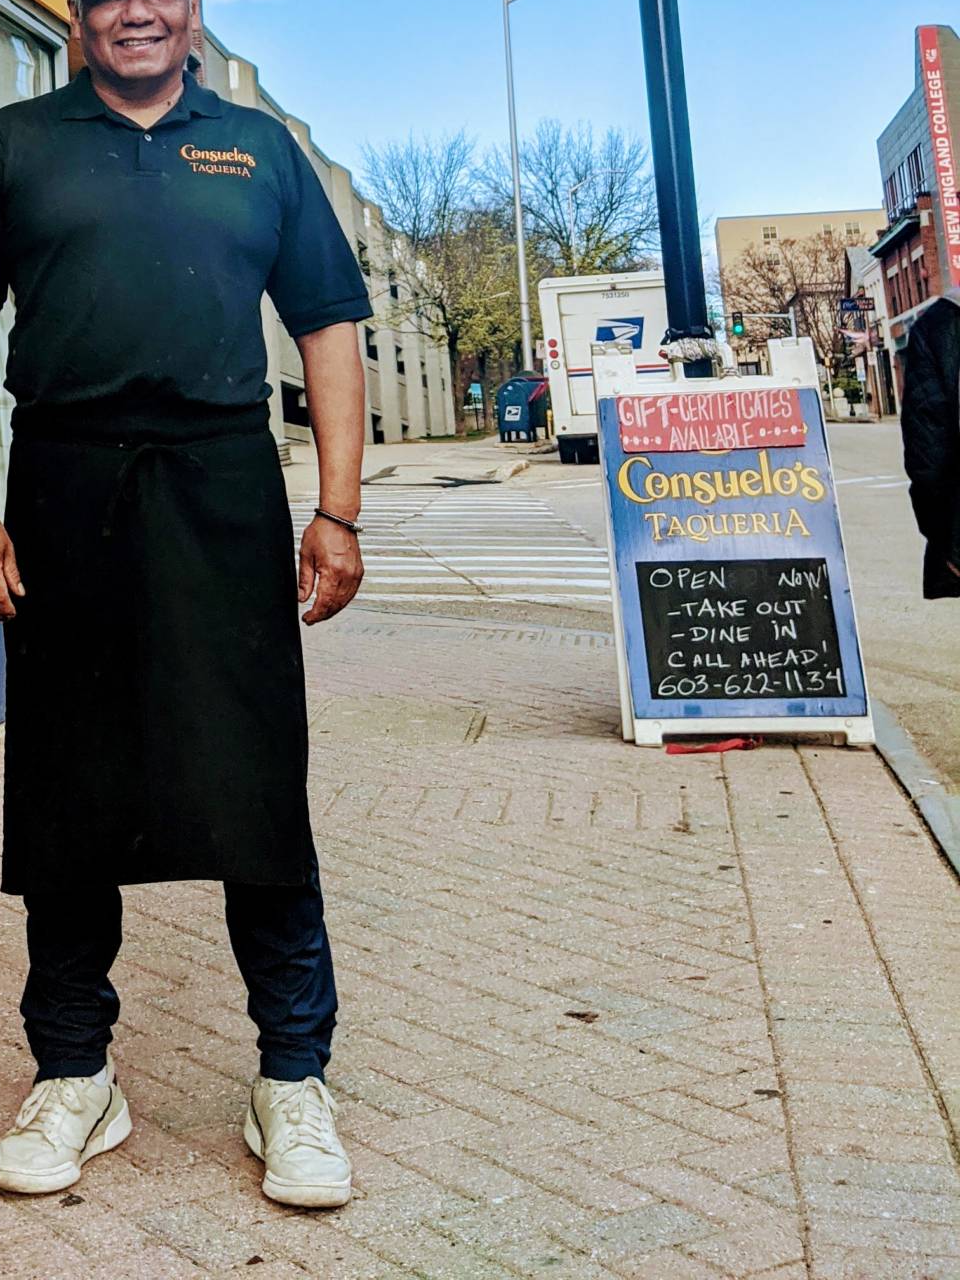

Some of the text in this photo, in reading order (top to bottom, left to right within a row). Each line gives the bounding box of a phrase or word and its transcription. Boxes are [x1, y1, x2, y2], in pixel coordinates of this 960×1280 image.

[179, 144, 256, 167] Consuelo's
[189, 162, 252, 178] TAQUERIA
[927, 69, 960, 245] NEW ENGLAND COLLEGE
[669, 422, 755, 451] AVAILABLE
[617, 449, 826, 505] Consuelo's
[644, 508, 811, 542] TAQUERIA
[649, 567, 727, 589] OPEN
[756, 599, 807, 616] OUT
[668, 640, 829, 669] CALL AHEAD!
[658, 667, 844, 697] 603-622-1134
